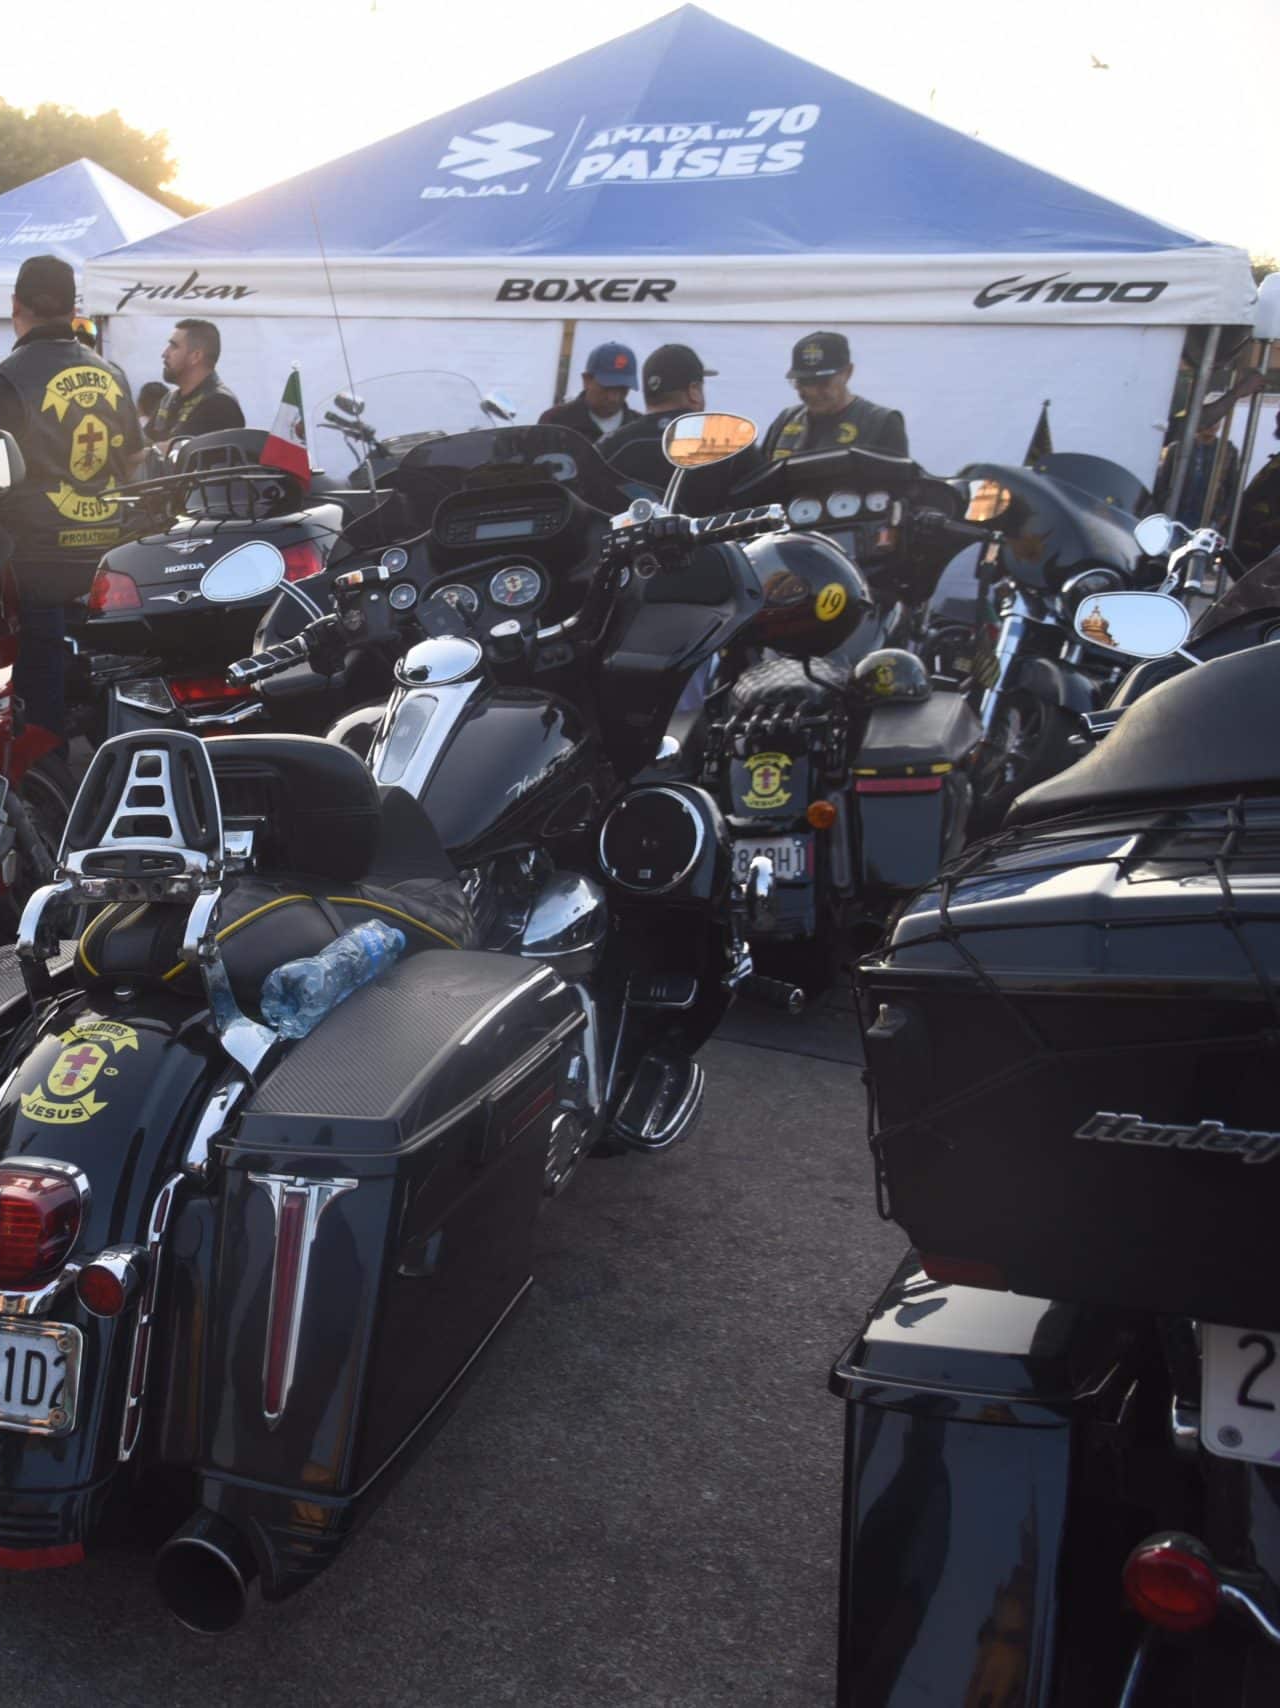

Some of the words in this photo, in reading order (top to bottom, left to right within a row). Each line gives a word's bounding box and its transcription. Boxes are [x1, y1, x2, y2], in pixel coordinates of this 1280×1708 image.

[585, 124, 713, 152] AMADA
[717, 126, 745, 141] EN
[745, 103, 821, 139] 70
[567, 141, 807, 188] PAÍSES
[420, 182, 529, 200] BAJAJ
[116, 269, 260, 312] pulsar
[495, 278, 677, 303] BOXER
[55, 371, 108, 397] SOLDIERS
[72, 500, 111, 518] JESUS
[164, 562, 206, 574] HONDA
[26, 1104, 83, 1120] JESUS
